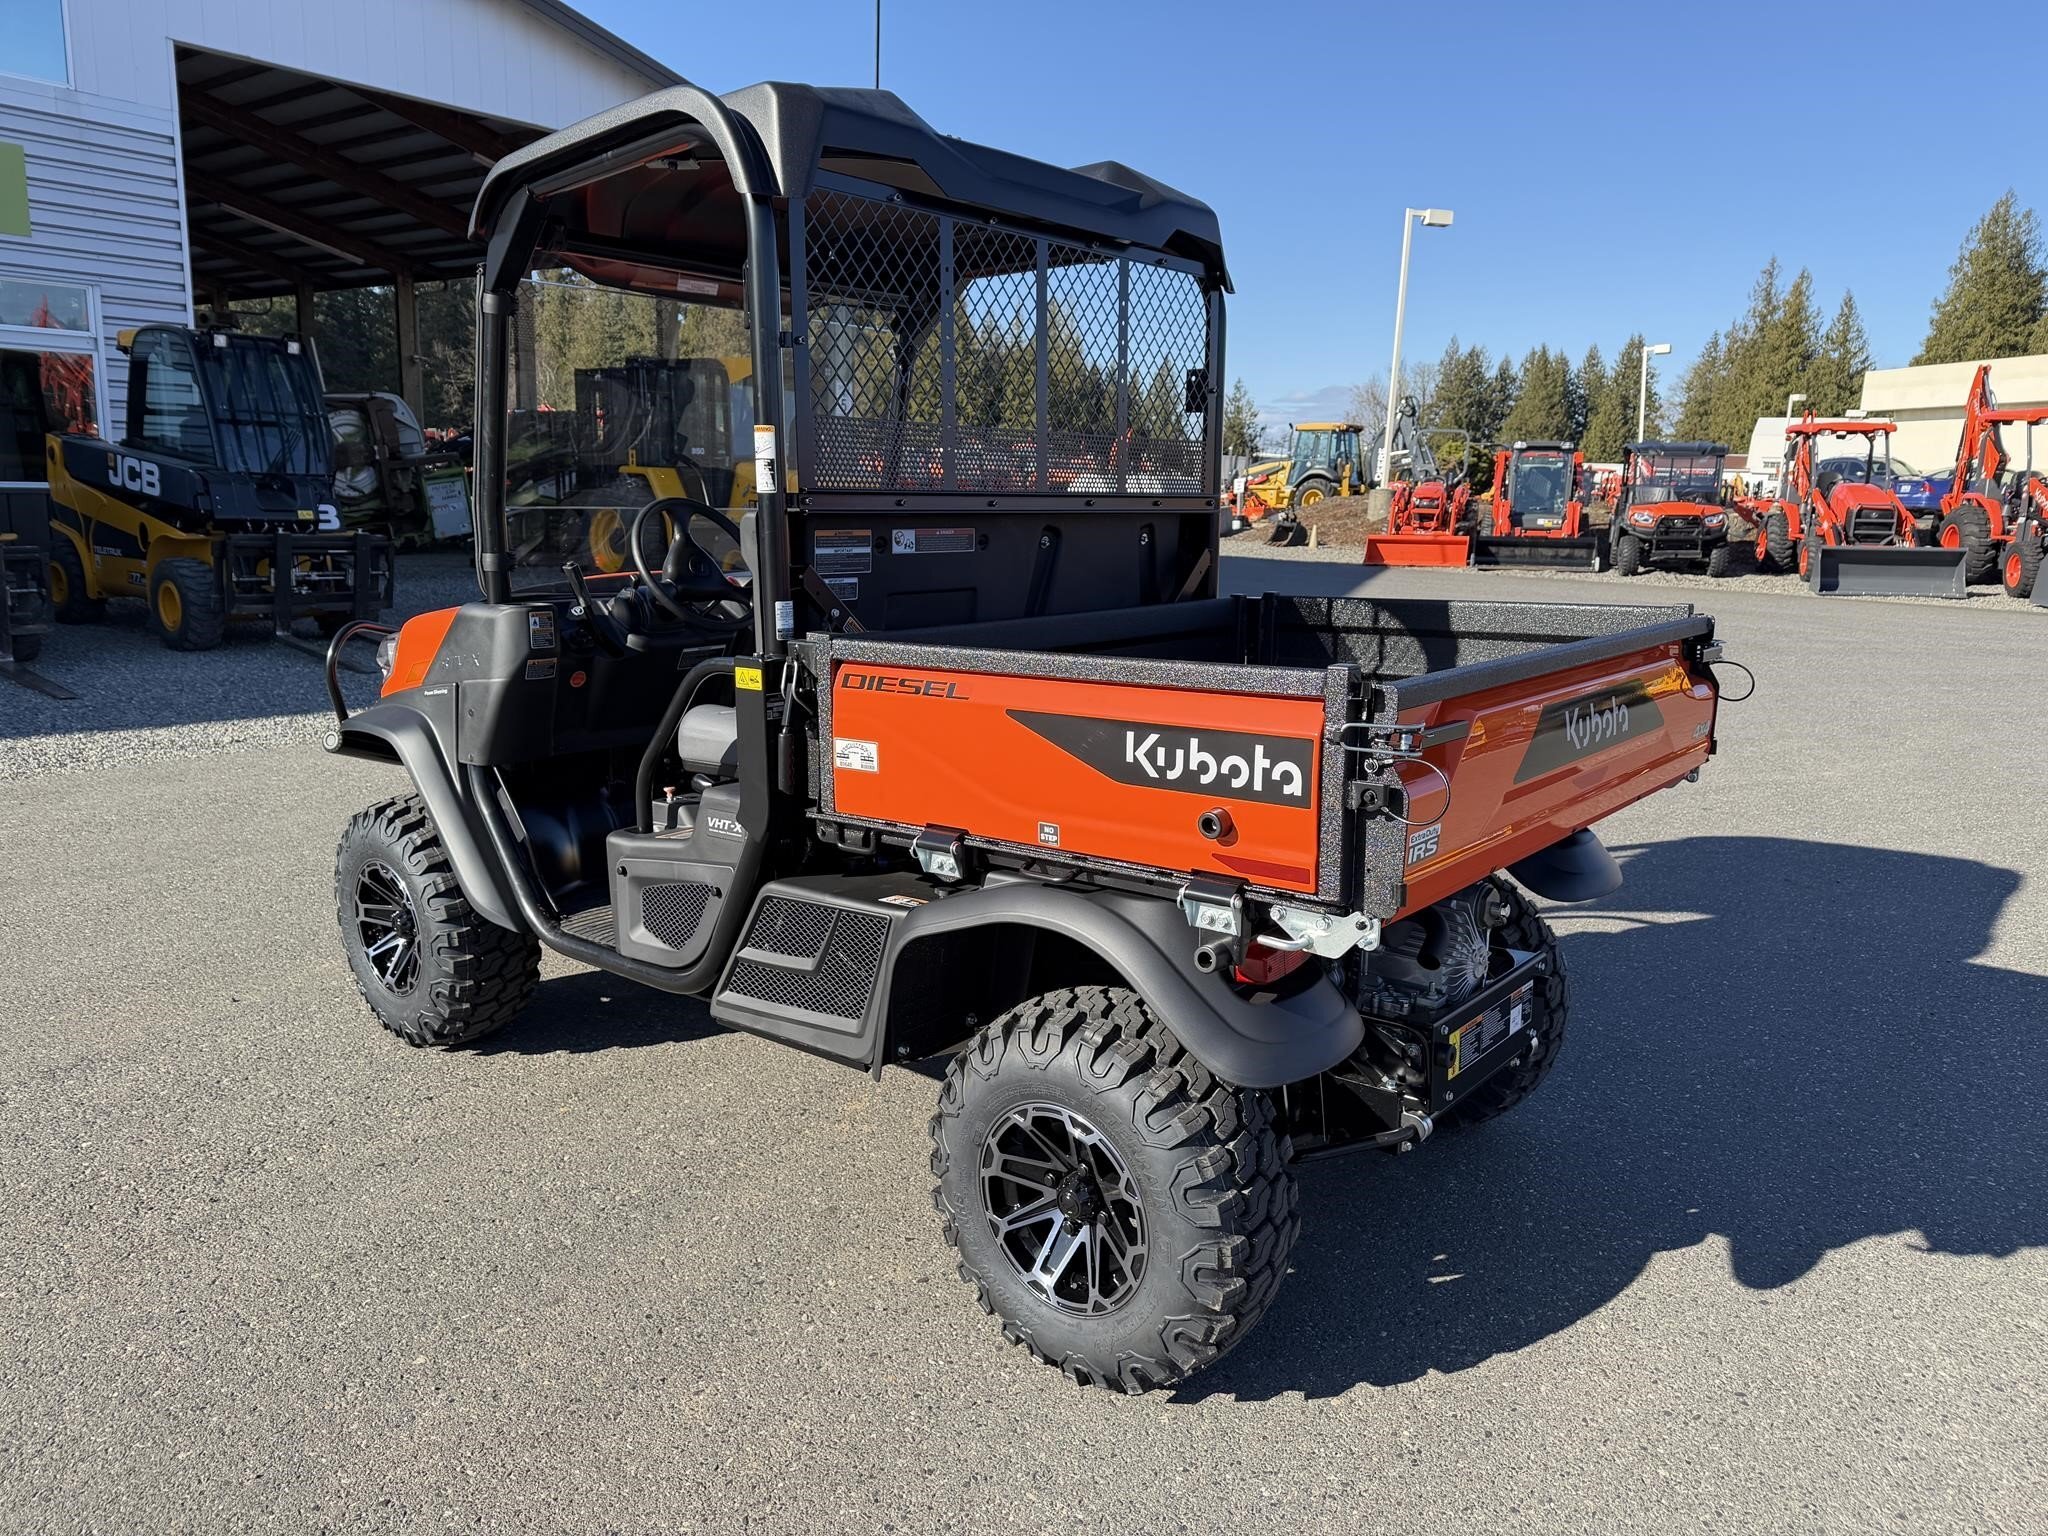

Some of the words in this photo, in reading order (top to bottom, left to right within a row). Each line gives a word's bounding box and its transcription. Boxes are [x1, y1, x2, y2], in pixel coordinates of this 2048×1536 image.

[108, 453, 160, 497] JCB
[841, 673, 970, 700] DIESEL
[1565, 696, 1629, 750] Kubota
[1126, 731, 1303, 797] Kubota
[707, 816, 743, 833] VHT-X
[1040, 833, 1058, 842] STEP
[1044, 826, 1055, 834] NO
[1408, 837, 1438, 865] IRS
